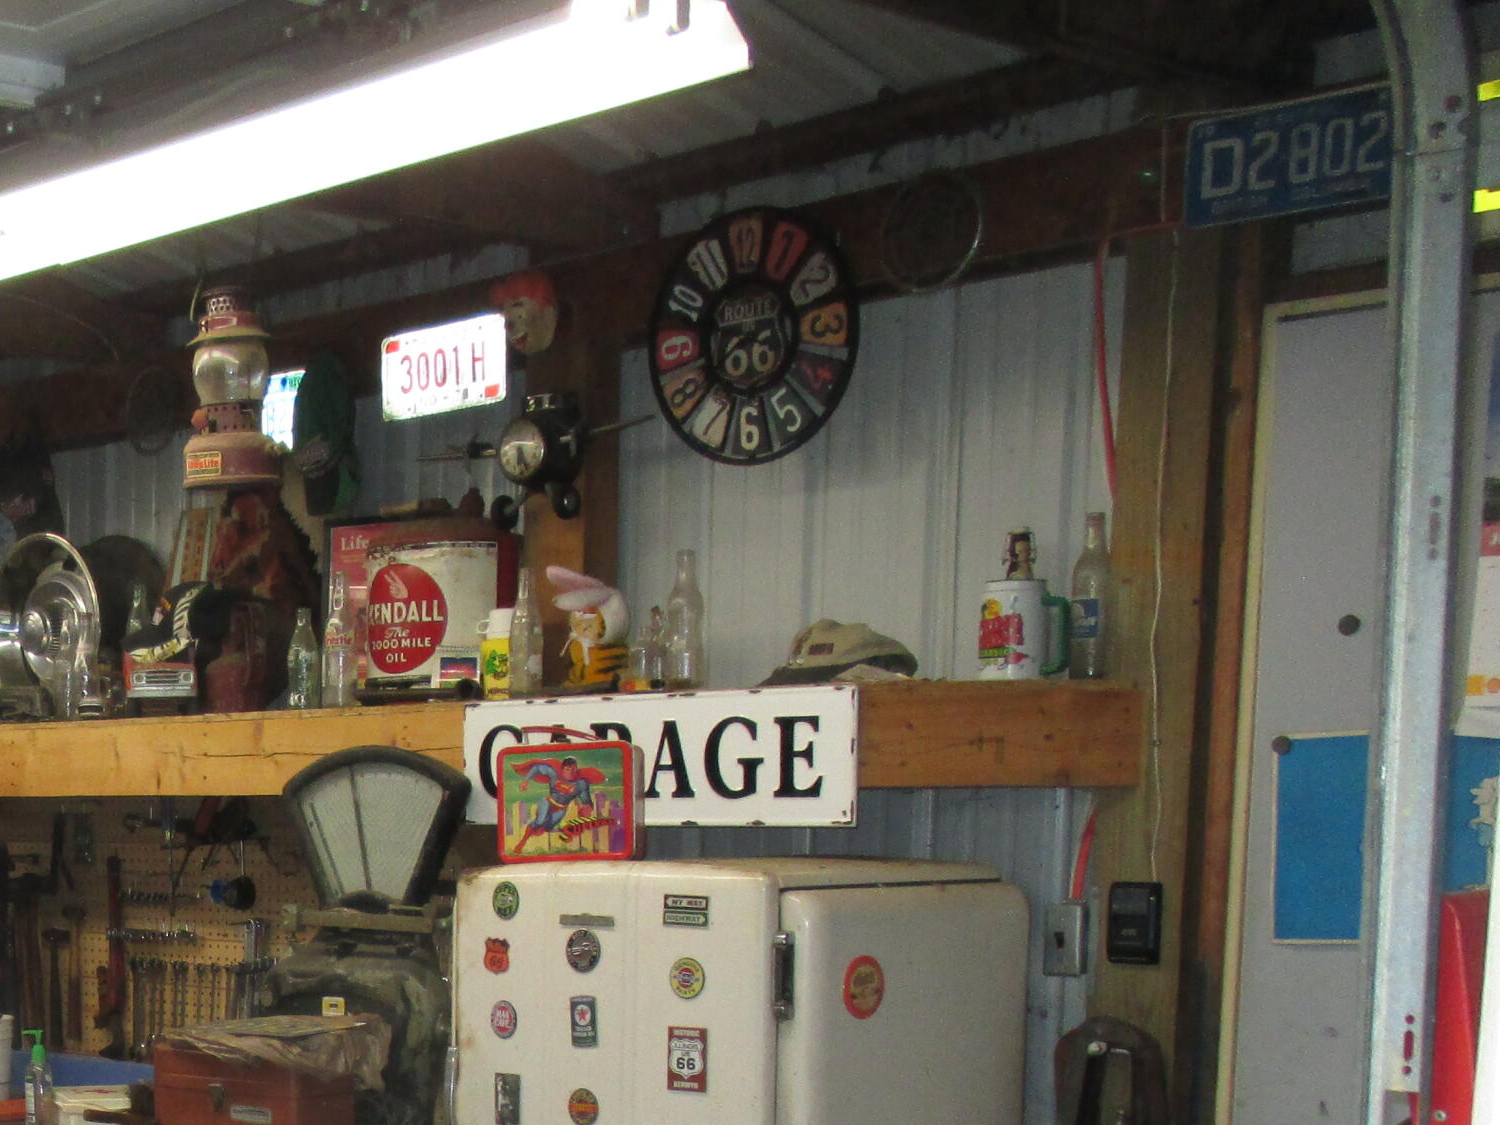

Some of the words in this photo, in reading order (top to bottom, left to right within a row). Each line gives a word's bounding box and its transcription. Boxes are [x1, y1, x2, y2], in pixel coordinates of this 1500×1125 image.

[723, 301, 772, 321] ROUTE
[811, 313, 844, 338] 3
[661, 335, 692, 361] 9
[725, 329, 775, 377] 66
[400, 345, 460, 394] 3001
[471, 341, 485, 382] H
[670, 377, 699, 407] 8
[771, 386, 801, 432] 5
[740, 406, 760, 450] 6
[340, 535, 370, 551] Life
[369, 599, 444, 626] KENDALL
[385, 627, 410, 639] The
[401, 637, 431, 648] MILE
[386, 653, 408, 663] OIL
[478, 715, 824, 800] AGE
[673, 1041, 699, 1051] ILLINOIS
[676, 1057, 697, 1071] 66
